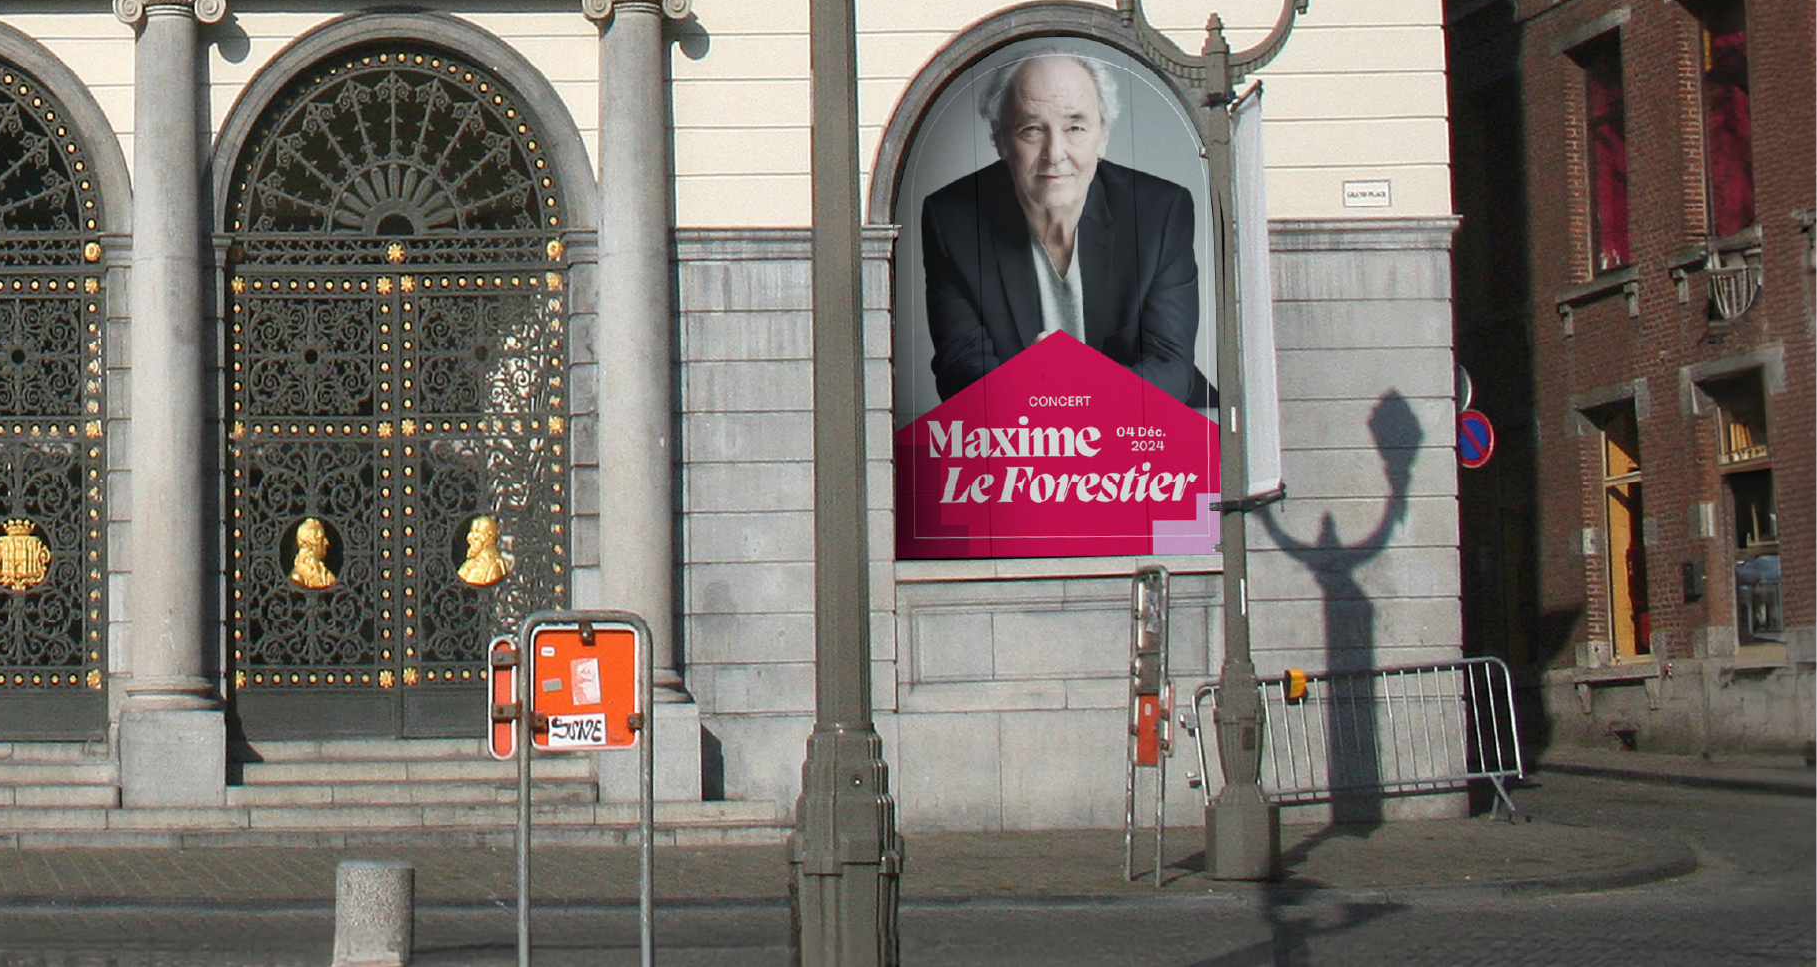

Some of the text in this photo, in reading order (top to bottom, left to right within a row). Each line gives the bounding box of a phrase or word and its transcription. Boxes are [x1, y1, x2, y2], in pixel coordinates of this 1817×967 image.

[1029, 395, 1092, 407] CONCERT
[927, 416, 1102, 459] Maxime
[1116, 426, 1167, 438] 04 Déc.
[1131, 440, 1165, 452] 2024
[939, 462, 1198, 504] Le Forestier
